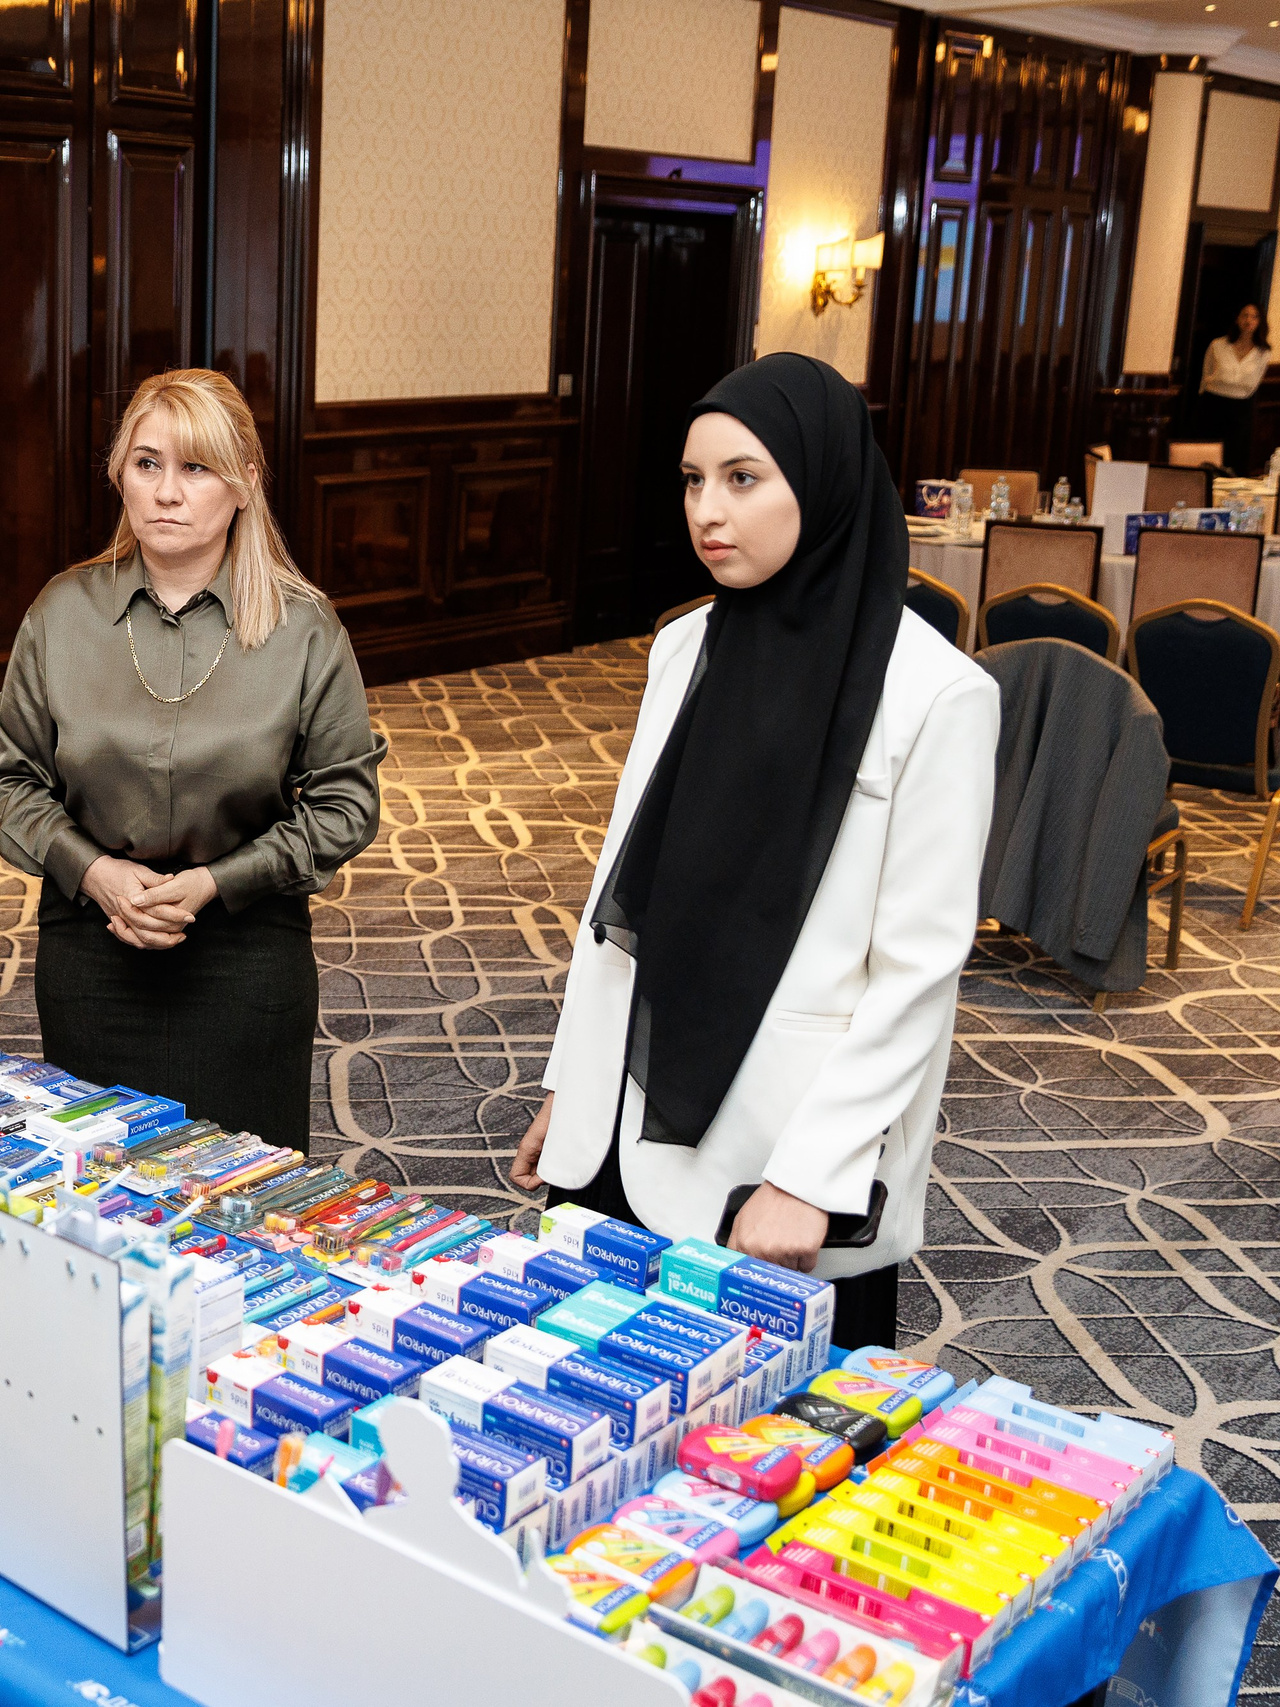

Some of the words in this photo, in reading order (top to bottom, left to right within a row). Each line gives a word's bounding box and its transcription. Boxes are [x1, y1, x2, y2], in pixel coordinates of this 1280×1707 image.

[130, 1118, 159, 1134] CURAPROX
[397, 1215, 438, 1237] CURAPROX
[600, 1220, 656, 1244] CURAPROX
[563, 1234, 579, 1248] kids
[542, 1253, 599, 1278] CURAPROX
[586, 1243, 639, 1271] CURAPROX
[477, 1275, 538, 1300] CURAPROX
[728, 1265, 810, 1297] CURAPROX
[269, 1291, 340, 1328] CURAPROX
[437, 1292, 455, 1306] kids
[668, 1278, 716, 1303] enzycal
[719, 1297, 798, 1335] CURAPROX
[372, 1322, 389, 1338] kids
[413, 1307, 473, 1334] CURAPROX
[636, 1312, 722, 1346] CURAPROX
[607, 1331, 694, 1369] CURAPROX
[557, 1358, 644, 1399] CURAPROX
[910, 1366, 942, 1388] CURAPROX
[492, 1392, 581, 1434] CURAPROX
